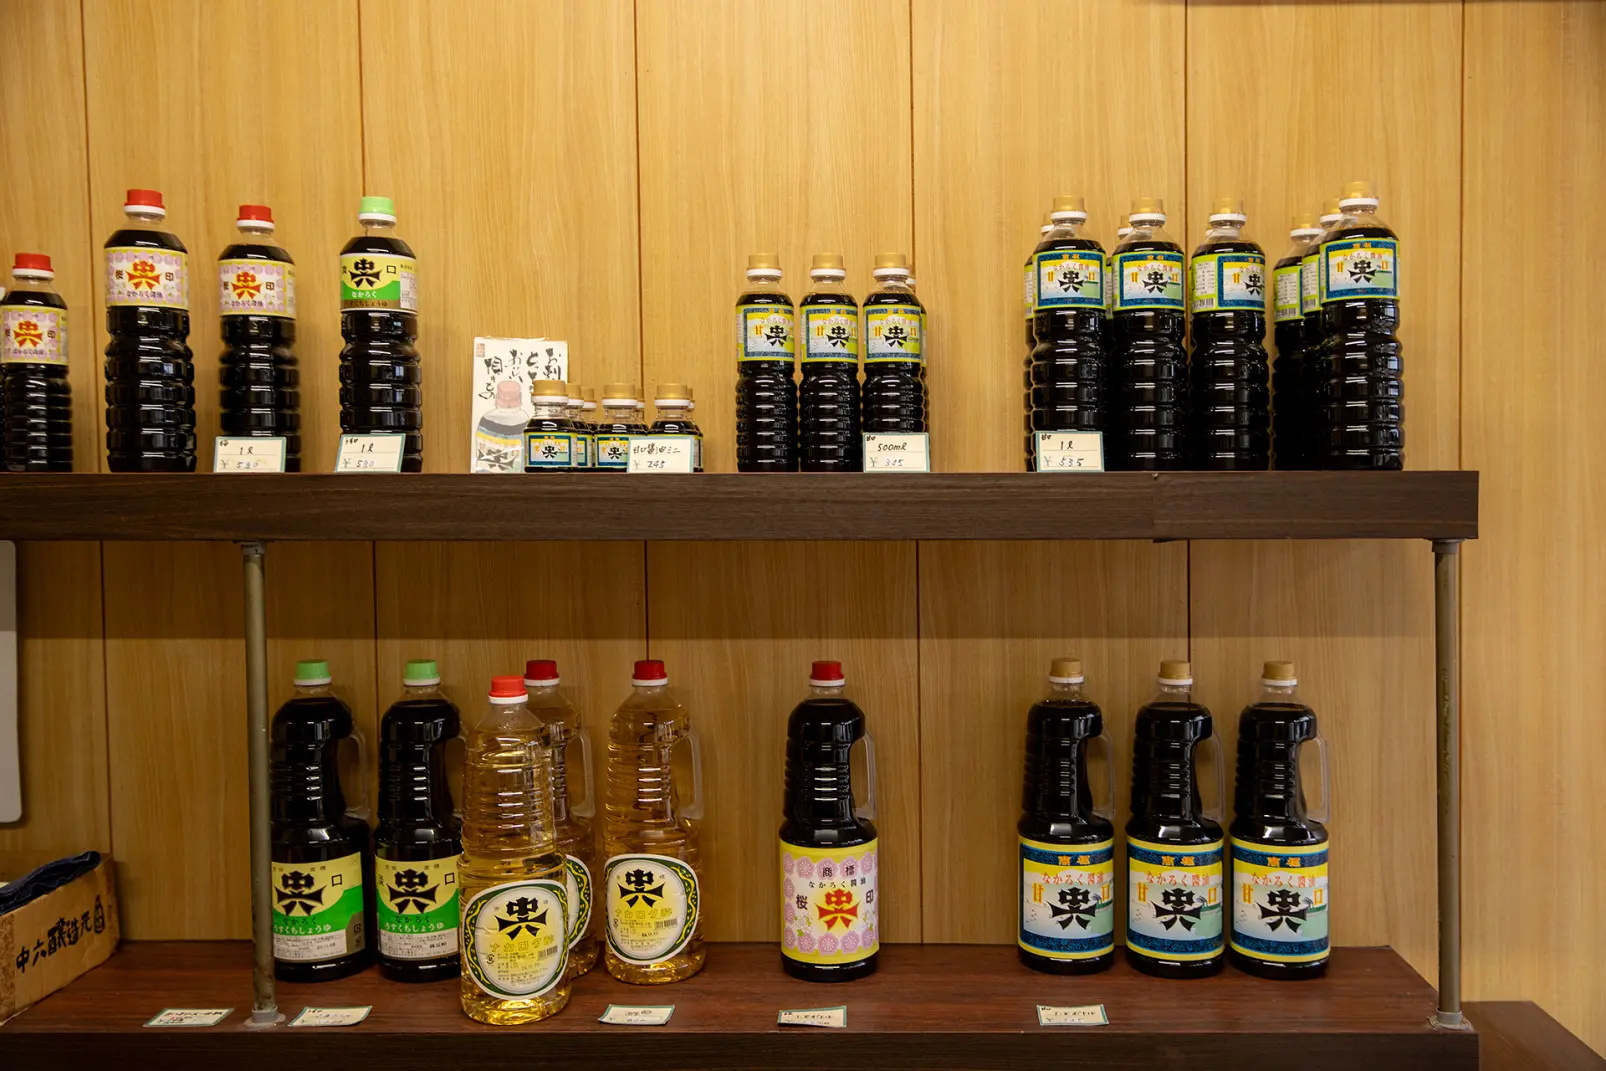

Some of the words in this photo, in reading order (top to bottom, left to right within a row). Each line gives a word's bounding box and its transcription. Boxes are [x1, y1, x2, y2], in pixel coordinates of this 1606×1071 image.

[331, 874, 343, 886] 口
[444, 872, 455, 886] 口
[822, 865, 855, 878] 商標
[796, 894, 808, 910] 桜
[865, 889, 875, 904] 印
[1032, 882, 1045, 904] 甘
[1136, 882, 1149, 903] 甘
[1242, 883, 1254, 904] 甘
